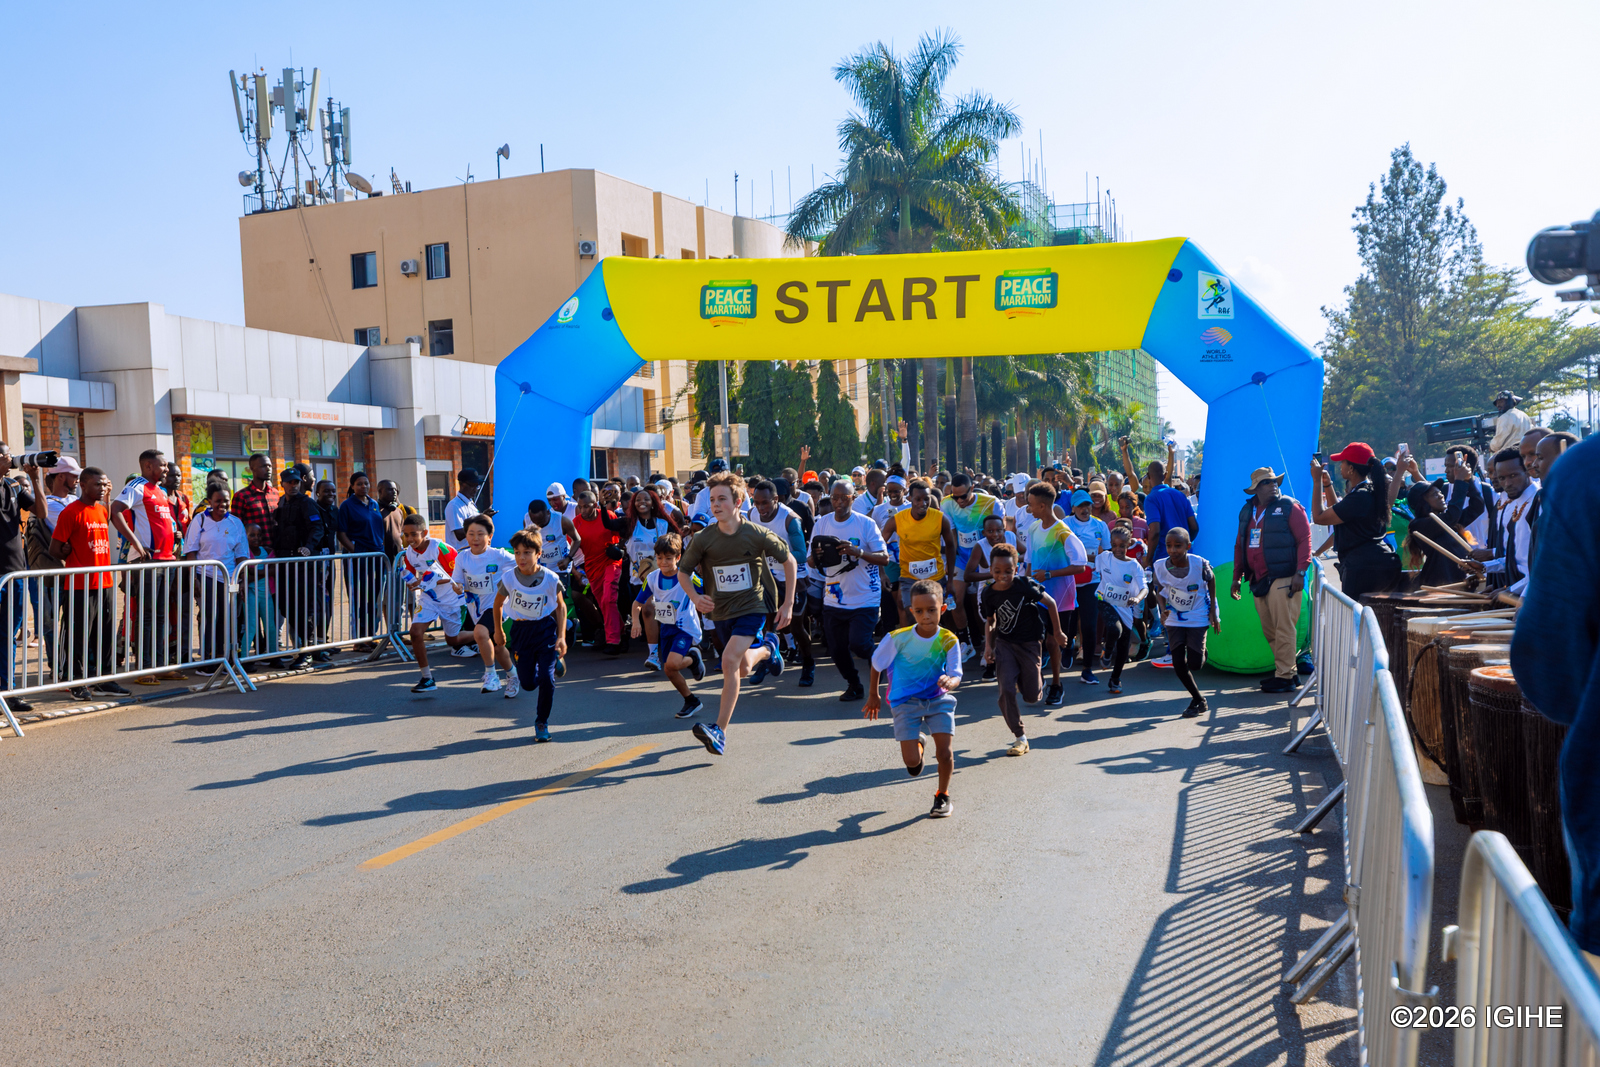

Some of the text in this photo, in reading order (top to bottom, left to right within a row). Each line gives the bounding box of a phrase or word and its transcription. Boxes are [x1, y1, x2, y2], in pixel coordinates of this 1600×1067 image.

[1001, 277, 1052, 296] PEACE
[705, 288, 752, 305] PEACE
[774, 274, 981, 324] START
[1000, 293, 1052, 306] MARATHON
[705, 304, 751, 315] MARATHON
[541, 551, 559, 559] 0622
[913, 565, 933, 575] 0847
[719, 573, 745, 583] 0421
[469, 580, 490, 588] 2917
[1107, 592, 1128, 601] 0010
[1171, 594, 1192, 606] 1562
[515, 597, 540, 610] 0377
